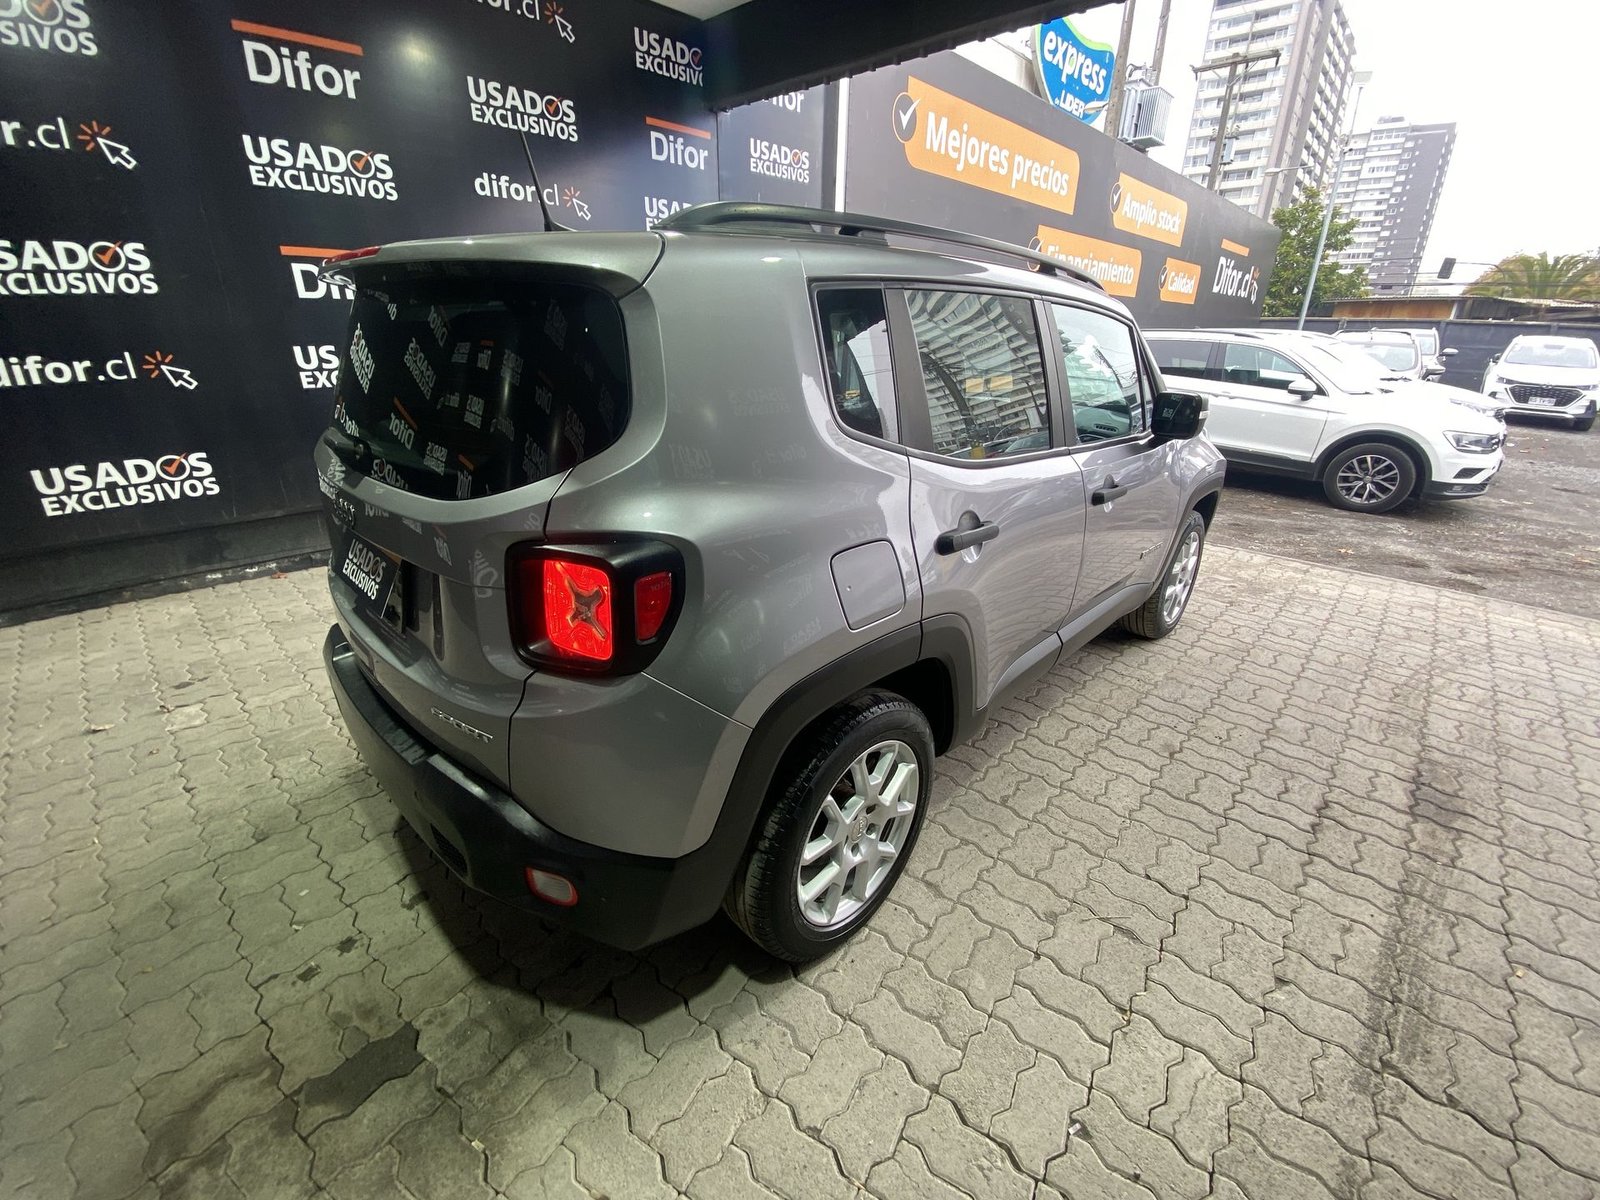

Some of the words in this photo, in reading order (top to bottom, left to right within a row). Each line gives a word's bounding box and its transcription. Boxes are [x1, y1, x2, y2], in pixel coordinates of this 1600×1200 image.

[242, 40, 361, 99] Difor
[1044, 31, 1107, 95] express
[467, 75, 576, 124] USADOS
[1060, 90, 1086, 118] LIDER
[470, 103, 578, 142] EXCLUSIVOS
[242, 134, 393, 179] USADOS
[650, 131, 708, 170] Difor
[750, 138, 809, 169] USADOS
[750, 158, 809, 183] EXCLUSIVOS
[925, 112, 1009, 172] Mejores
[1011, 153, 1069, 196] precios
[249, 166, 398, 201] EXCLUSIVOS
[474, 172, 559, 206] difor.cl
[1122, 193, 1156, 228] Amplio
[1158, 209, 1182, 234] stock
[1167, 271, 1196, 294] Calidad
[1212, 256, 1254, 299] Difor.cl
[30, 452, 213, 496] USADOS
[41, 477, 220, 516] EXCLUSIVOS
[342, 558, 379, 600] EXCLUSIVOS
[348, 538, 387, 583] USADOS
